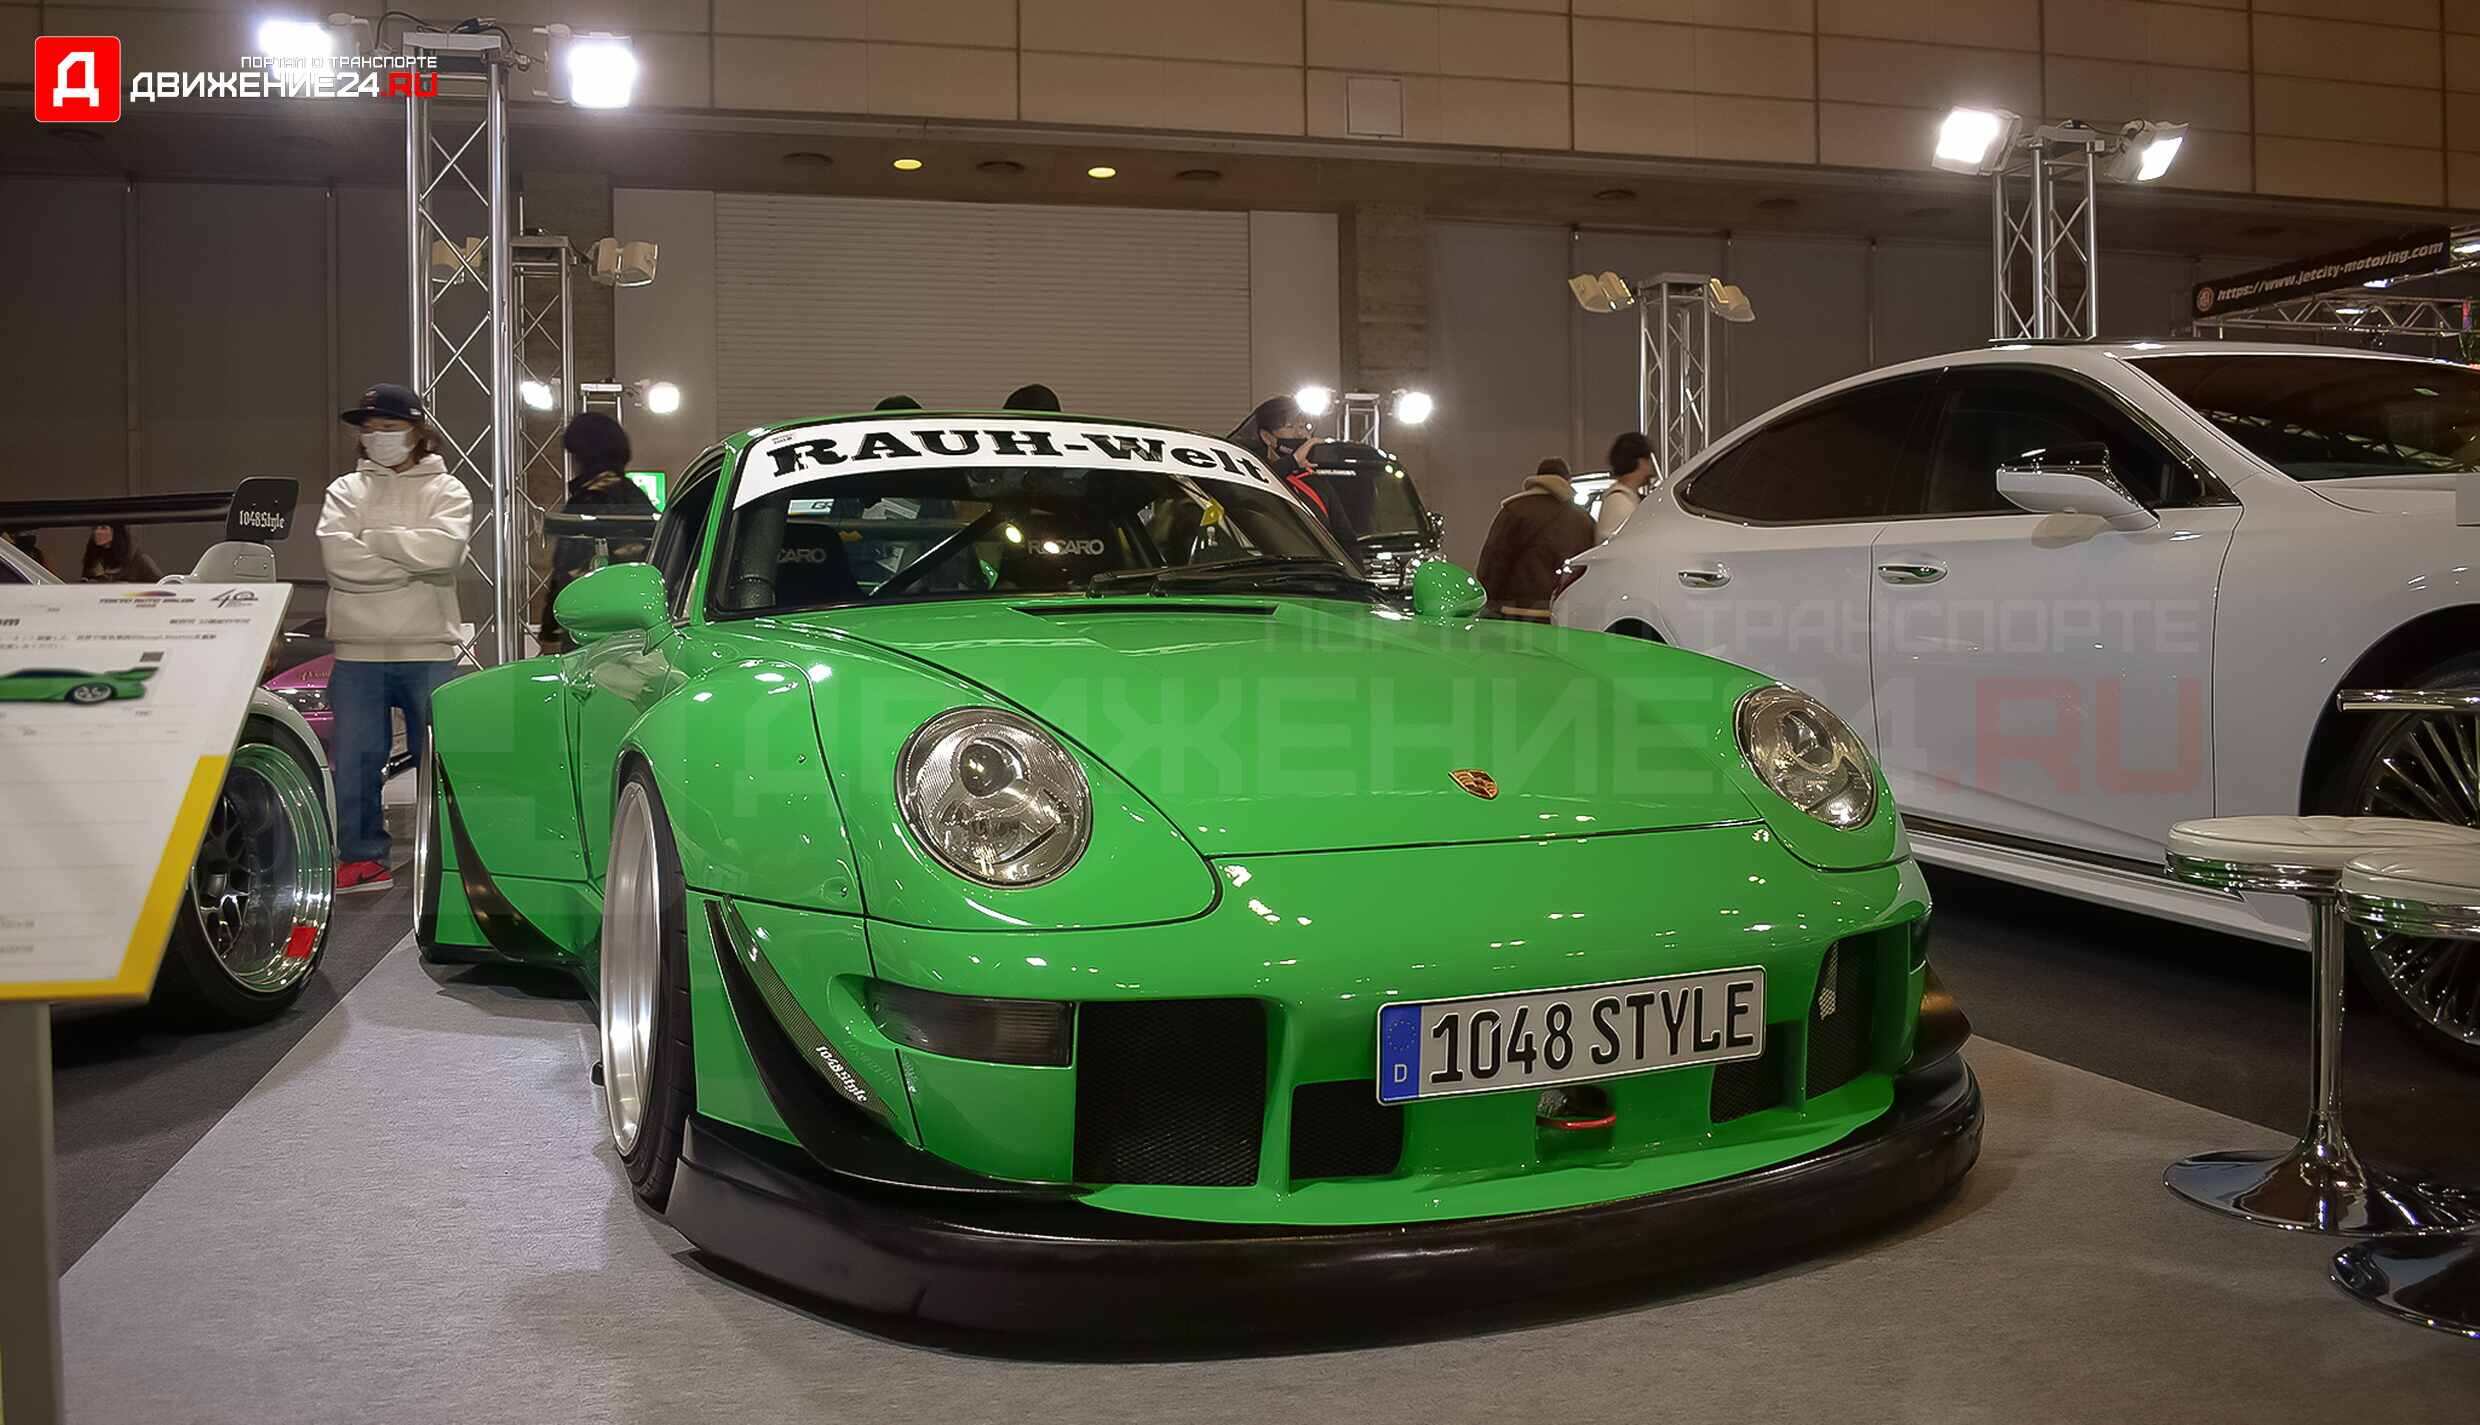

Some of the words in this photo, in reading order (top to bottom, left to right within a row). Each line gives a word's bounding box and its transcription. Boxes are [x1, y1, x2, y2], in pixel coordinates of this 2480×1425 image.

[766, 429, 1270, 483] RAUH-Welt
[776, 548, 827, 564] CARO
[1028, 538, 1105, 556] RCARO
[1431, 1001, 1576, 1084] 1048
[1589, 982, 1755, 1066] STYLE
[1394, 1064, 1409, 1083] D
